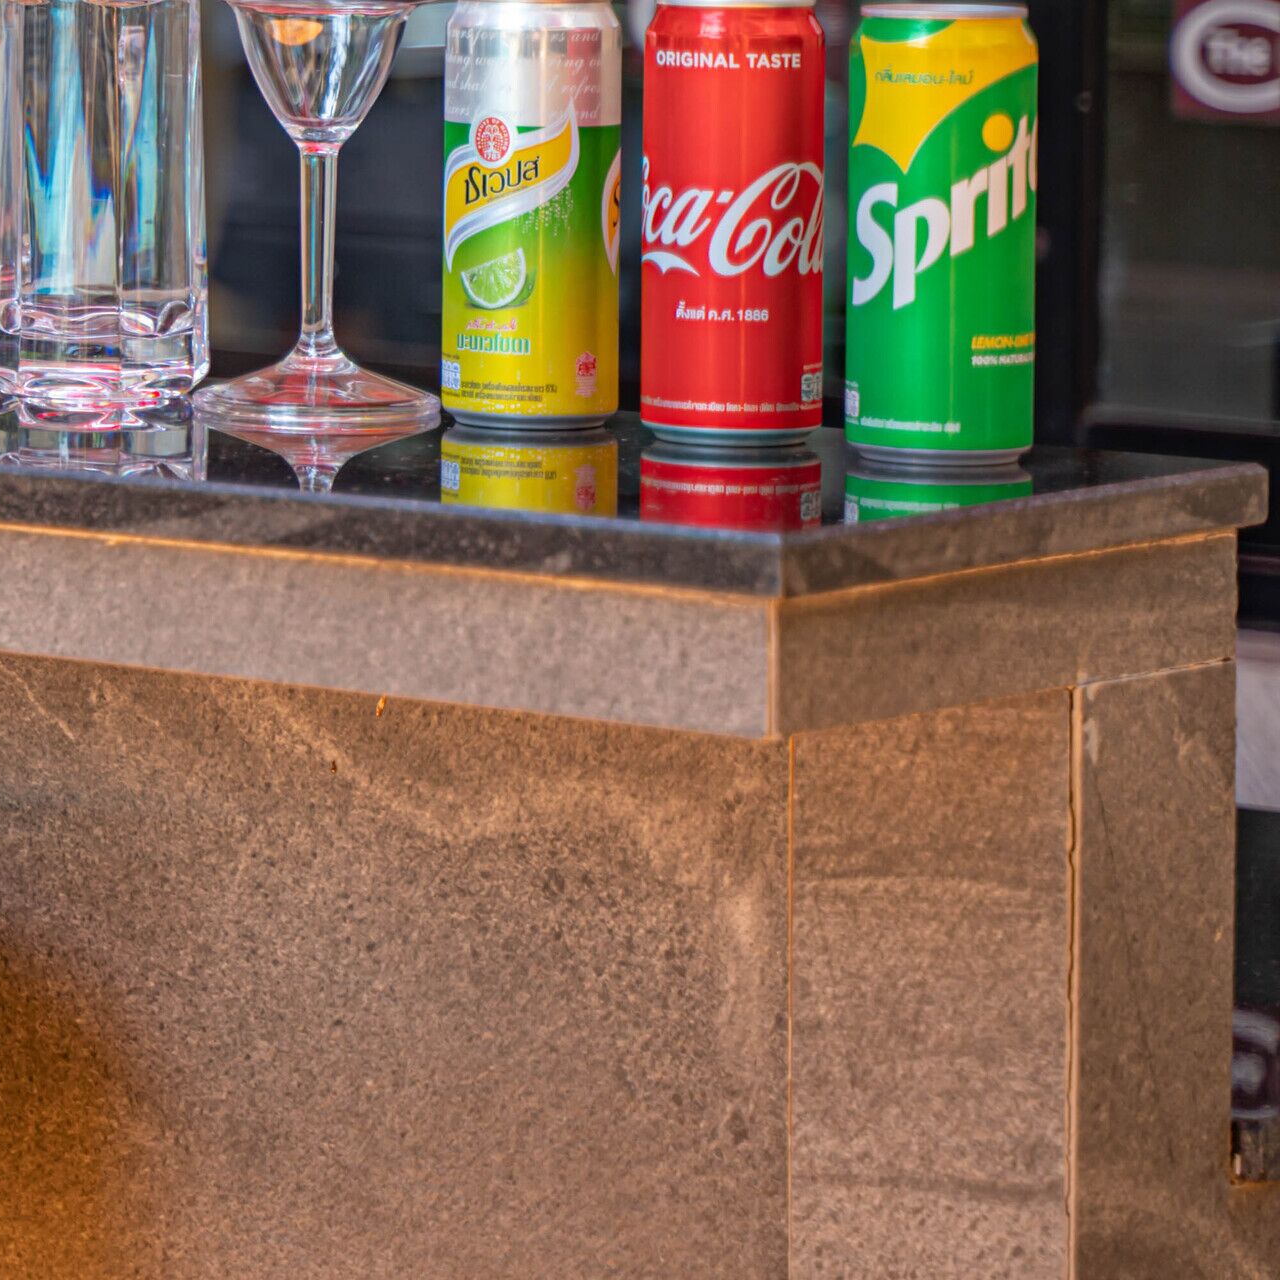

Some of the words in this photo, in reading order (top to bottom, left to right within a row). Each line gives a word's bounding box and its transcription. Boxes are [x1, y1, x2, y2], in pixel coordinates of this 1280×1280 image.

[656, 50, 740, 68] ORIGINAL
[746, 53, 801, 69] TASTE
[738, 308, 768, 322] 1886
